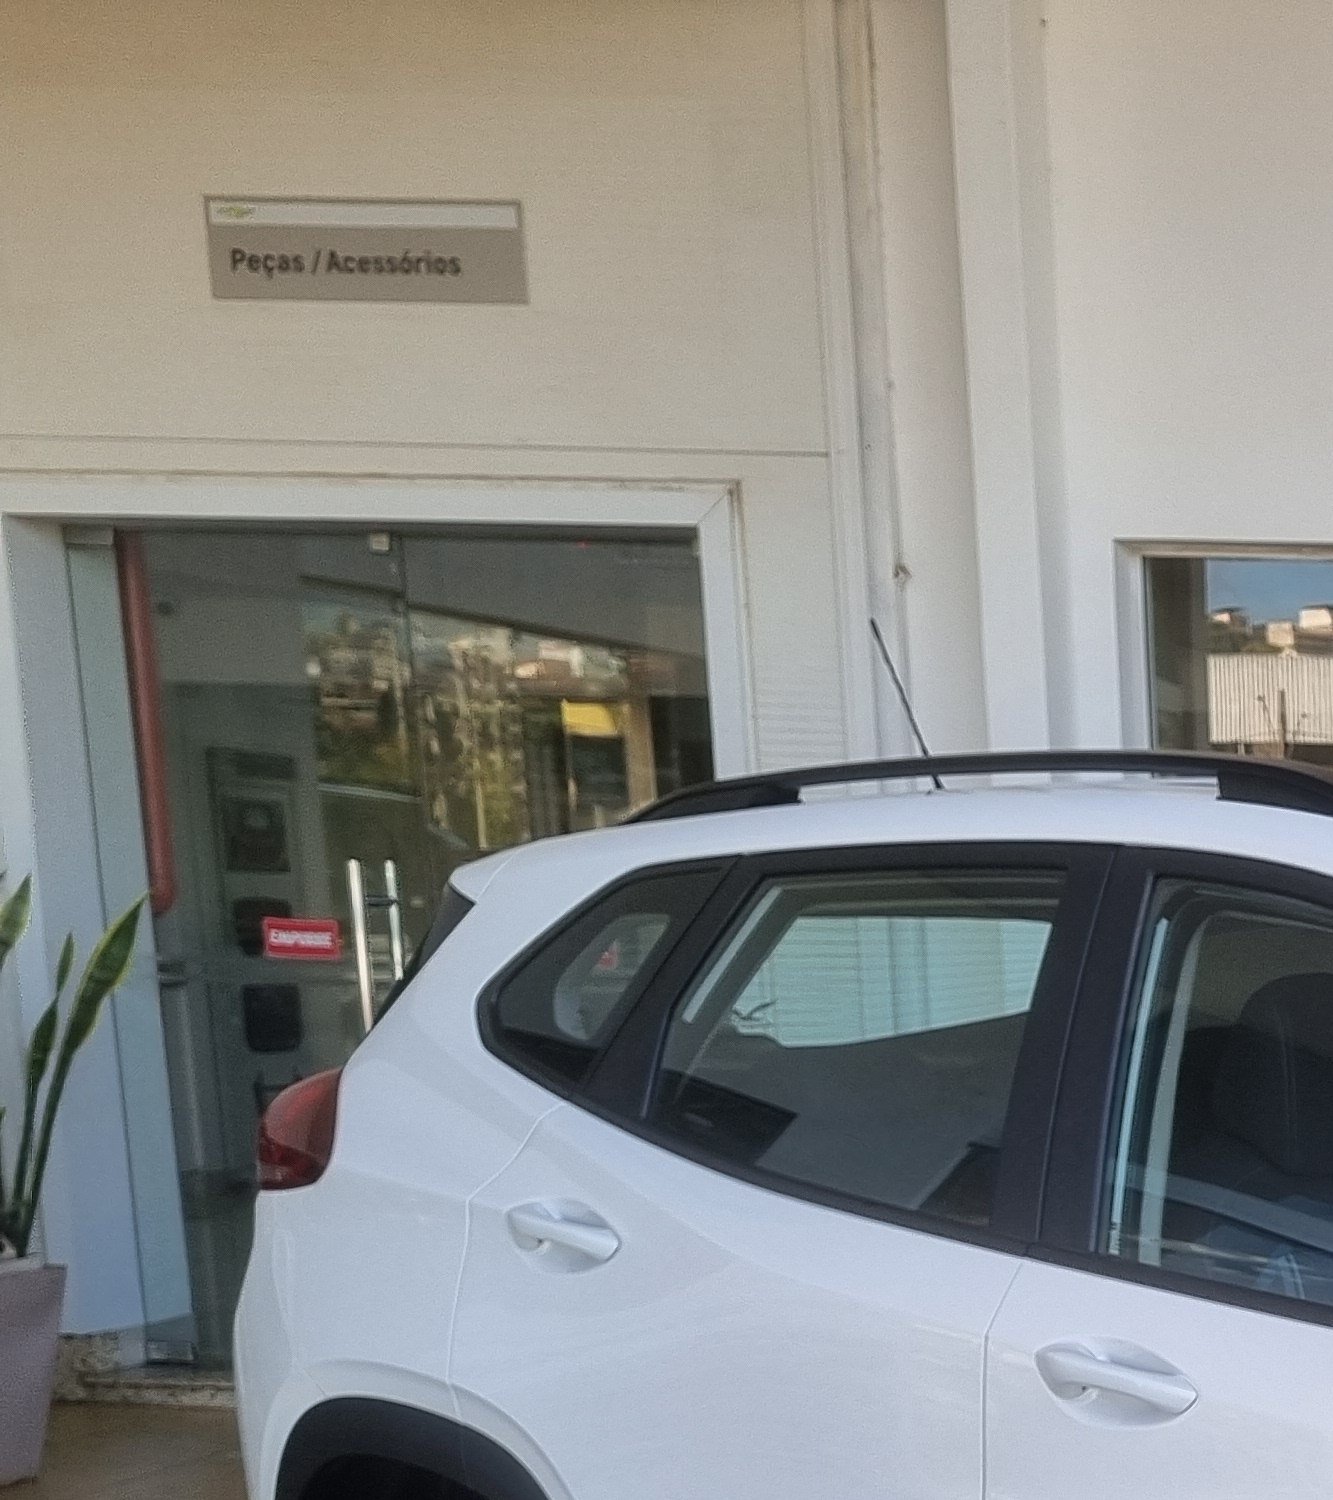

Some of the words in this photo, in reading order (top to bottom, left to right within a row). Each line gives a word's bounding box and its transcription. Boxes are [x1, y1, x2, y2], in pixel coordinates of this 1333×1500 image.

[230, 247, 305, 278] Peças
[311, 249, 322, 275] /
[326, 249, 462, 276] Acessórios
